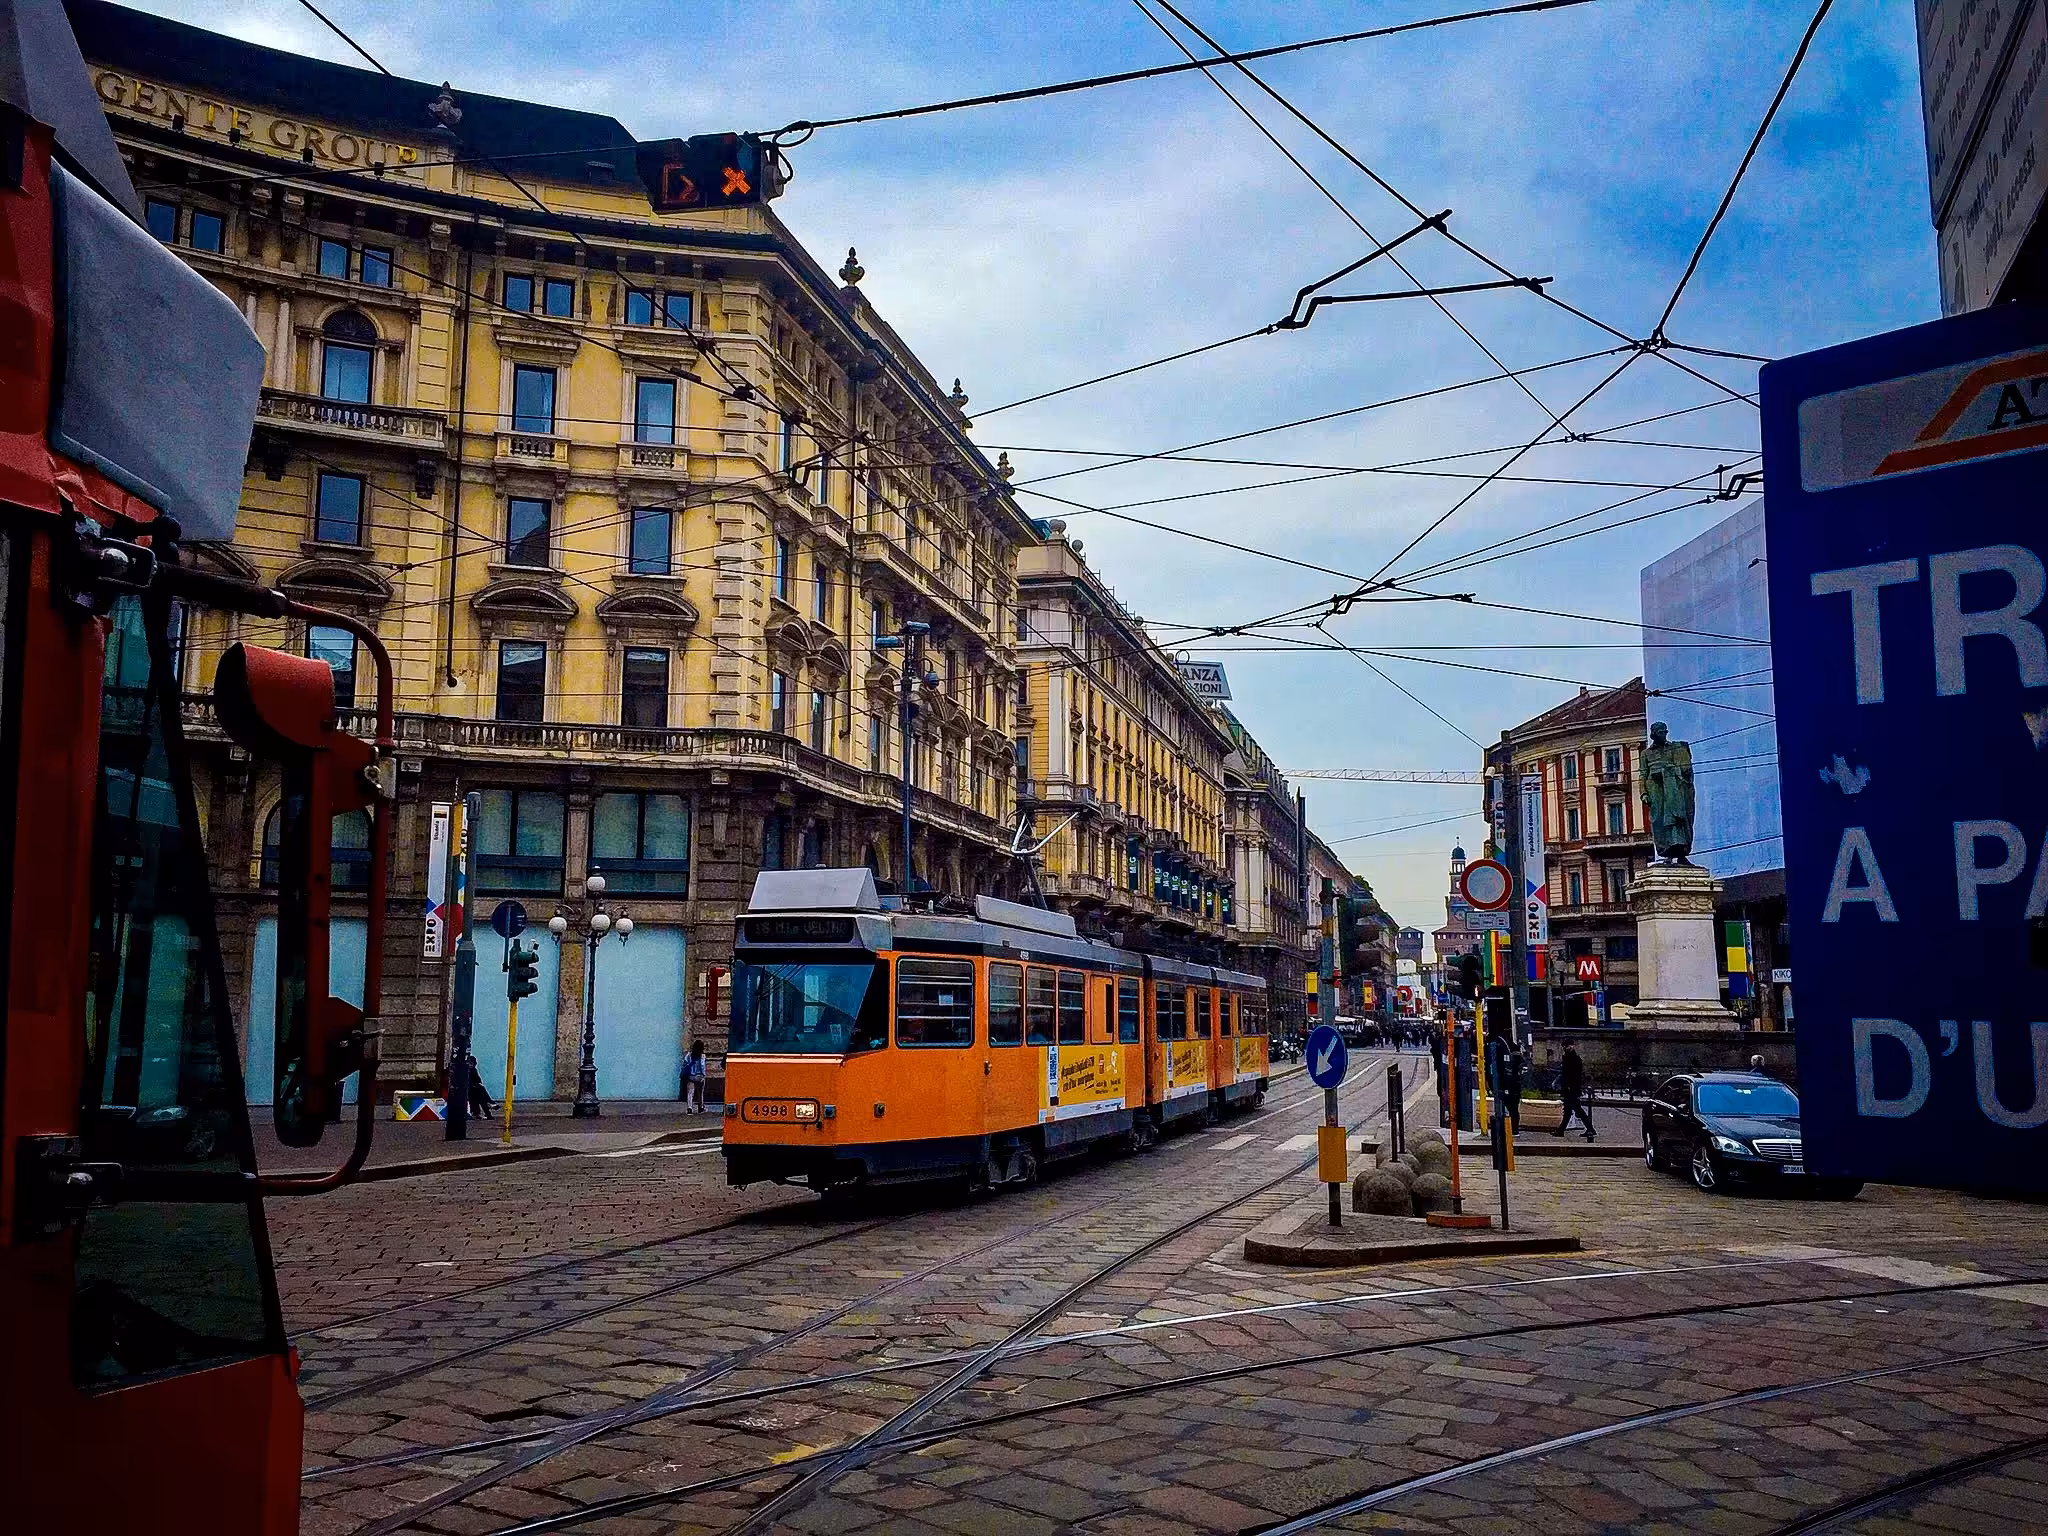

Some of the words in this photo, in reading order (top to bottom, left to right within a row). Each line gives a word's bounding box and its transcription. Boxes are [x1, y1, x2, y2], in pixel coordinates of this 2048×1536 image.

[95, 71, 255, 139] GENTE
[269, 119, 417, 173] GROUP
[1965, 151, 2000, 238] controllo
[2001, 37, 2047, 159] elettronico
[2006, 131, 2036, 220] accessi
[1495, 801, 1506, 840] EXPO
[1821, 827, 1900, 923] A
[425, 918, 437, 952] EXPO
[1528, 901, 1540, 939] EXPO
[1578, 960, 1600, 976] M
[1774, 970, 1792, 979] KIKO
[751, 1104, 788, 1117] 4998
